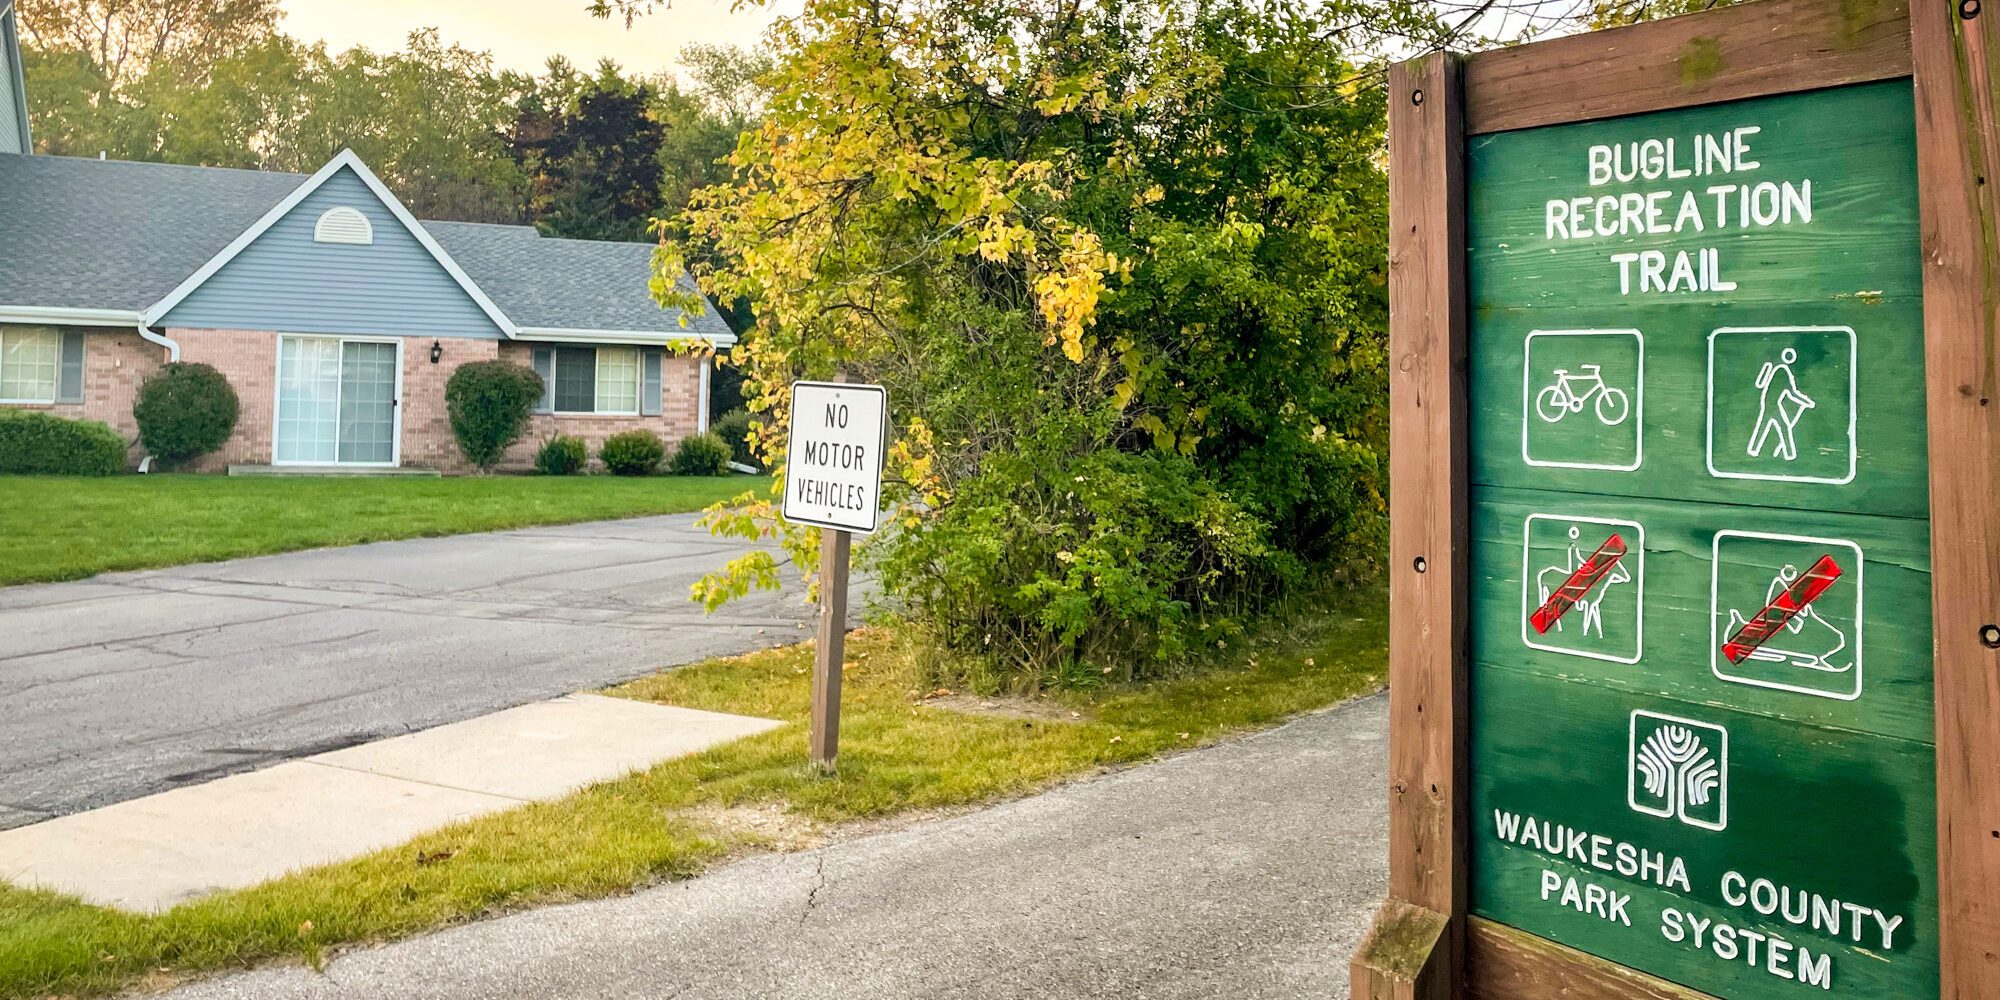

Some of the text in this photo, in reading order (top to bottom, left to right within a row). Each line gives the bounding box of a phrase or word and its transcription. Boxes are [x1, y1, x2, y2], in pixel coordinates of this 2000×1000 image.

[1588, 125, 1761, 187] BUGLINE
[1545, 178, 1813, 240] RECREATION
[1610, 247, 1738, 296] TRAIL
[825, 403, 848, 429] NO
[804, 440, 865, 471] MOTOR
[798, 478, 864, 511] VEHICLES
[1494, 808, 1903, 950] WAUKESHA COUNTY
[1541, 869, 1832, 990] PARK SYSTEM
